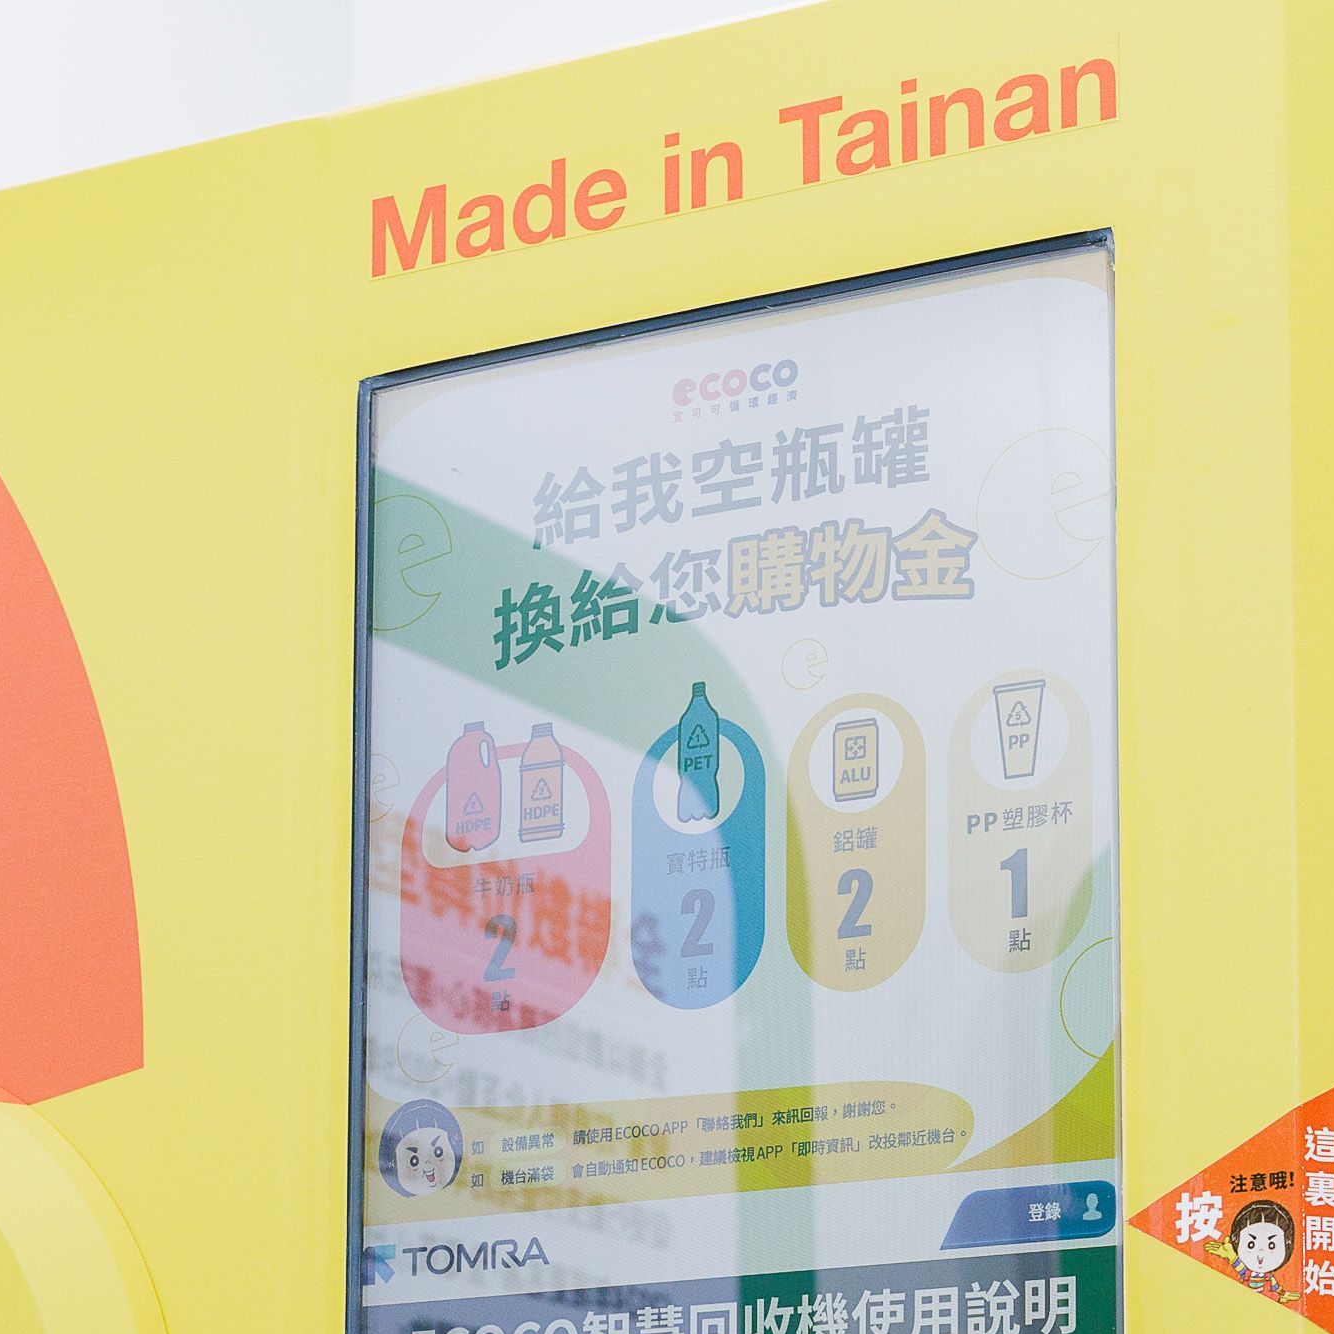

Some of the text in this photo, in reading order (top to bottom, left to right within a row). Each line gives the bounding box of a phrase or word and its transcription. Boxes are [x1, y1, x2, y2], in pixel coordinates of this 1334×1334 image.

[370, 57, 1117, 278] Made in Tainan
[672, 359, 799, 407] ecoco
[533, 404, 931, 550] 給我空瓶罐
[493, 507, 978, 670] 換給您購物金
[1008, 733, 1030, 750] PP
[684, 754, 713, 772] PET
[839, 766, 871, 785] ALU
[523, 801, 560, 821] HDPE
[455, 817, 492, 835] HDPE
[833, 825, 878, 853] 鋁罐
[667, 845, 731, 876] 寶特瓶
[1000, 847, 1028, 919] 1
[837, 868, 874, 939] 2
[680, 888, 714, 958] 2
[483, 914, 518, 982] 2
[1008, 928, 1032, 953] 點
[845, 947, 867, 972] 點
[686, 965, 708, 991] 點
[471, 1140, 485, 1156] 如
[501, 1132, 555, 1153] 設備異常
[470, 1172, 484, 1189] 如
[501, 1165, 555, 1186] 機台滿袋
[1028, 1202, 1061, 1223] 登錄
[1175, 1191, 1224, 1244] 按
[402, 1236, 550, 1277] TOMRA
